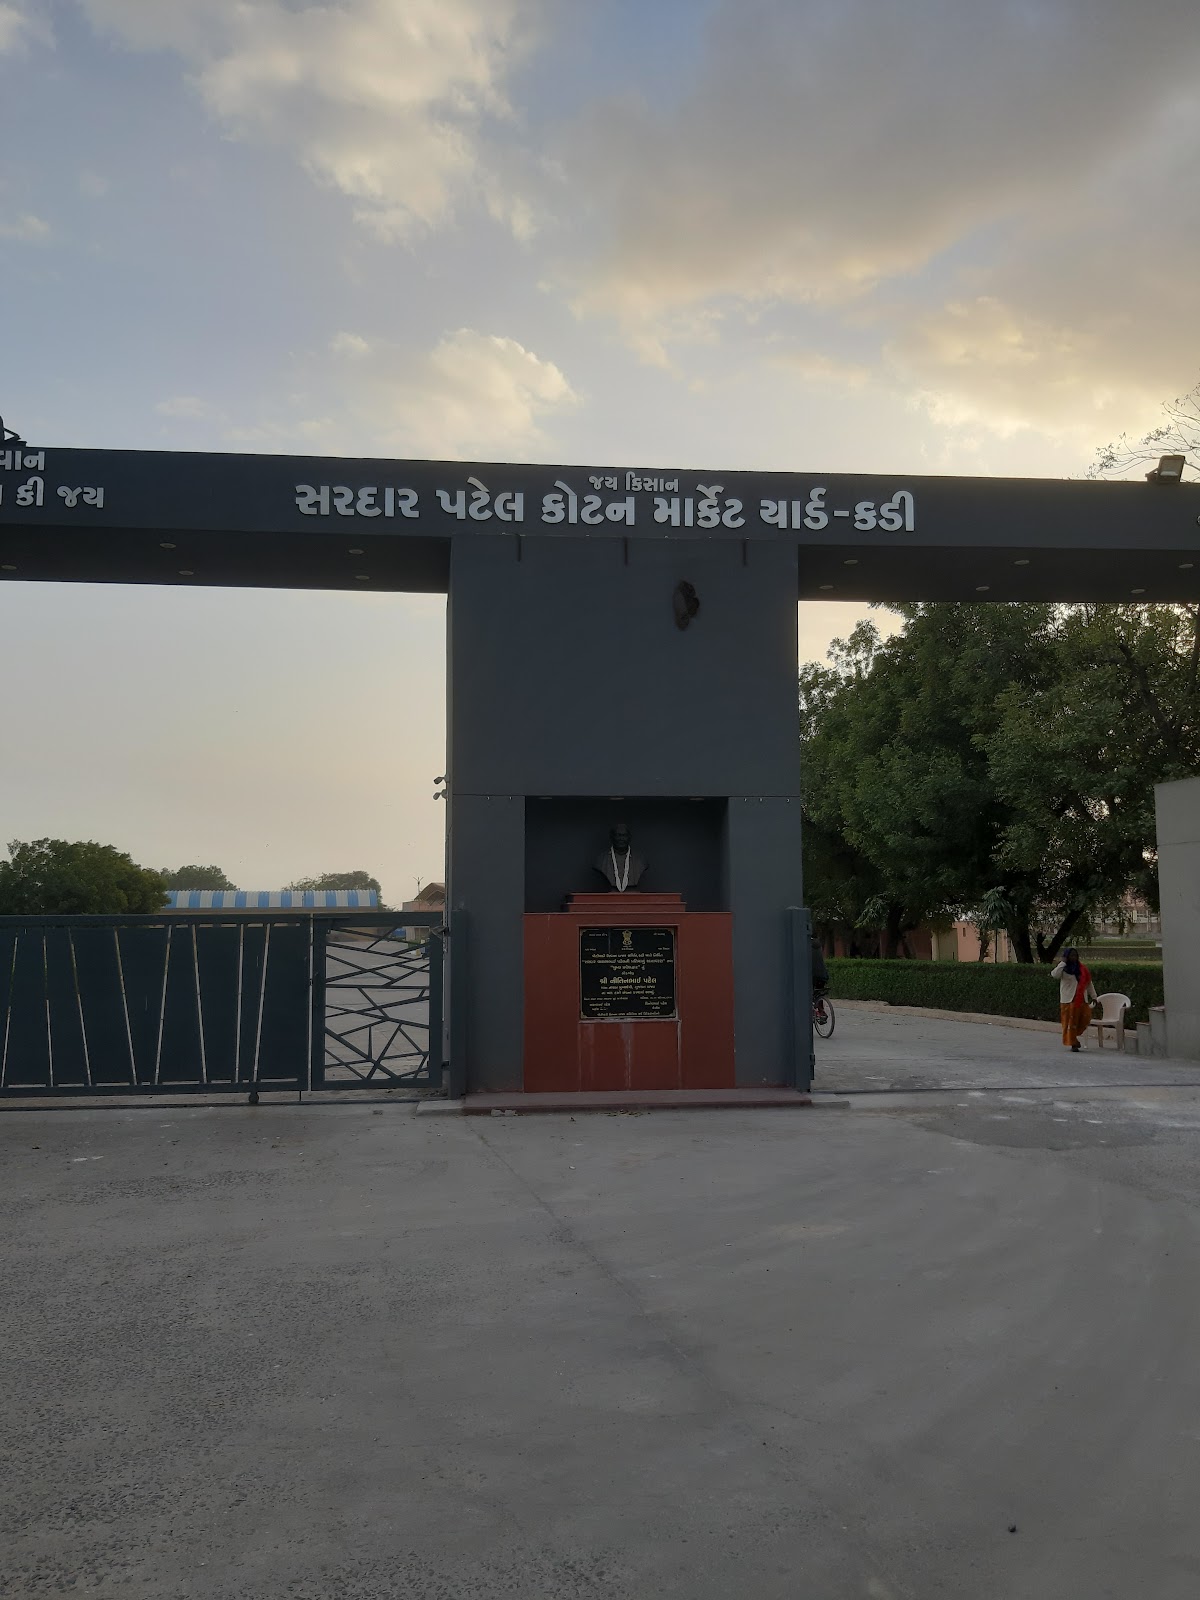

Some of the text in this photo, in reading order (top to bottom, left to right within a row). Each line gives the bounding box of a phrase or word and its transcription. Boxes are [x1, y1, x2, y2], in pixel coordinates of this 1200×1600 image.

[15, 476, 44, 506] કી
[56, 485, 104, 508] જય
[588, 471, 679, 493] જય કિસાન
[295, 484, 420, 518] સરદાર
[435, 476, 525, 522] પટેલ
[540, 479, 636, 526] કોટન
[653, 483, 746, 529] માર્કેટ
